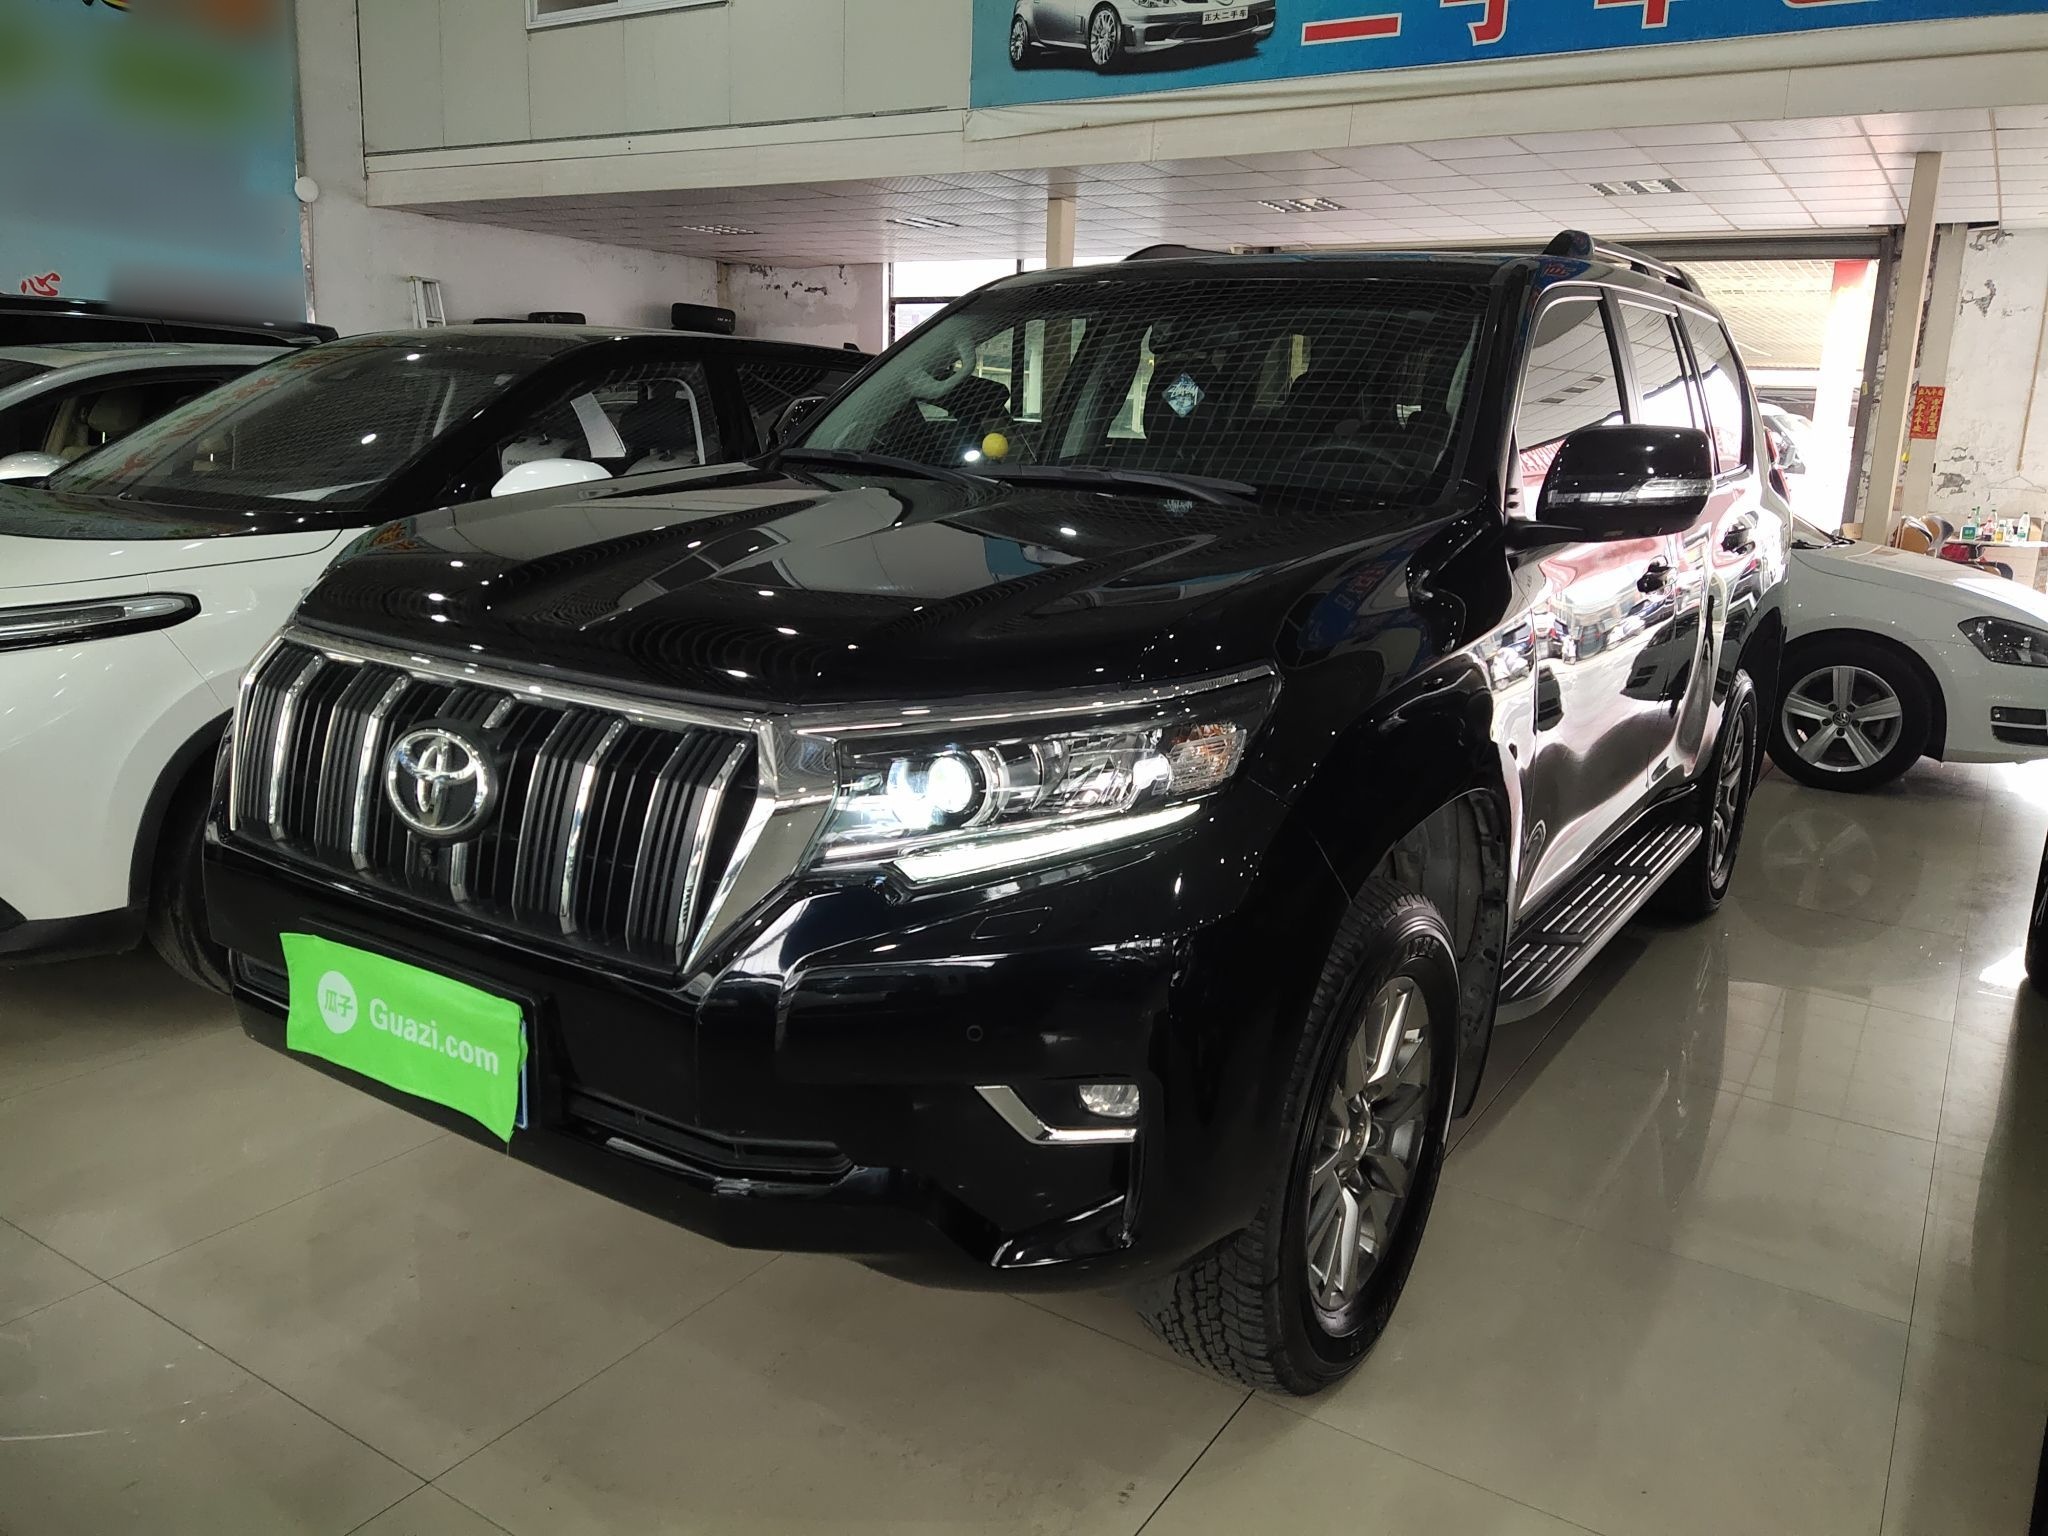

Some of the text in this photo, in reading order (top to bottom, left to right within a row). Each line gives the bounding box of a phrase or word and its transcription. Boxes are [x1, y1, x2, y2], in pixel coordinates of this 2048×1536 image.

[1204, 9, 1247, 21] 正大二手车
[20, 272, 61, 297] 心
[325, 988, 354, 1018] 瓜子
[369, 997, 498, 1075] Guazi.com
